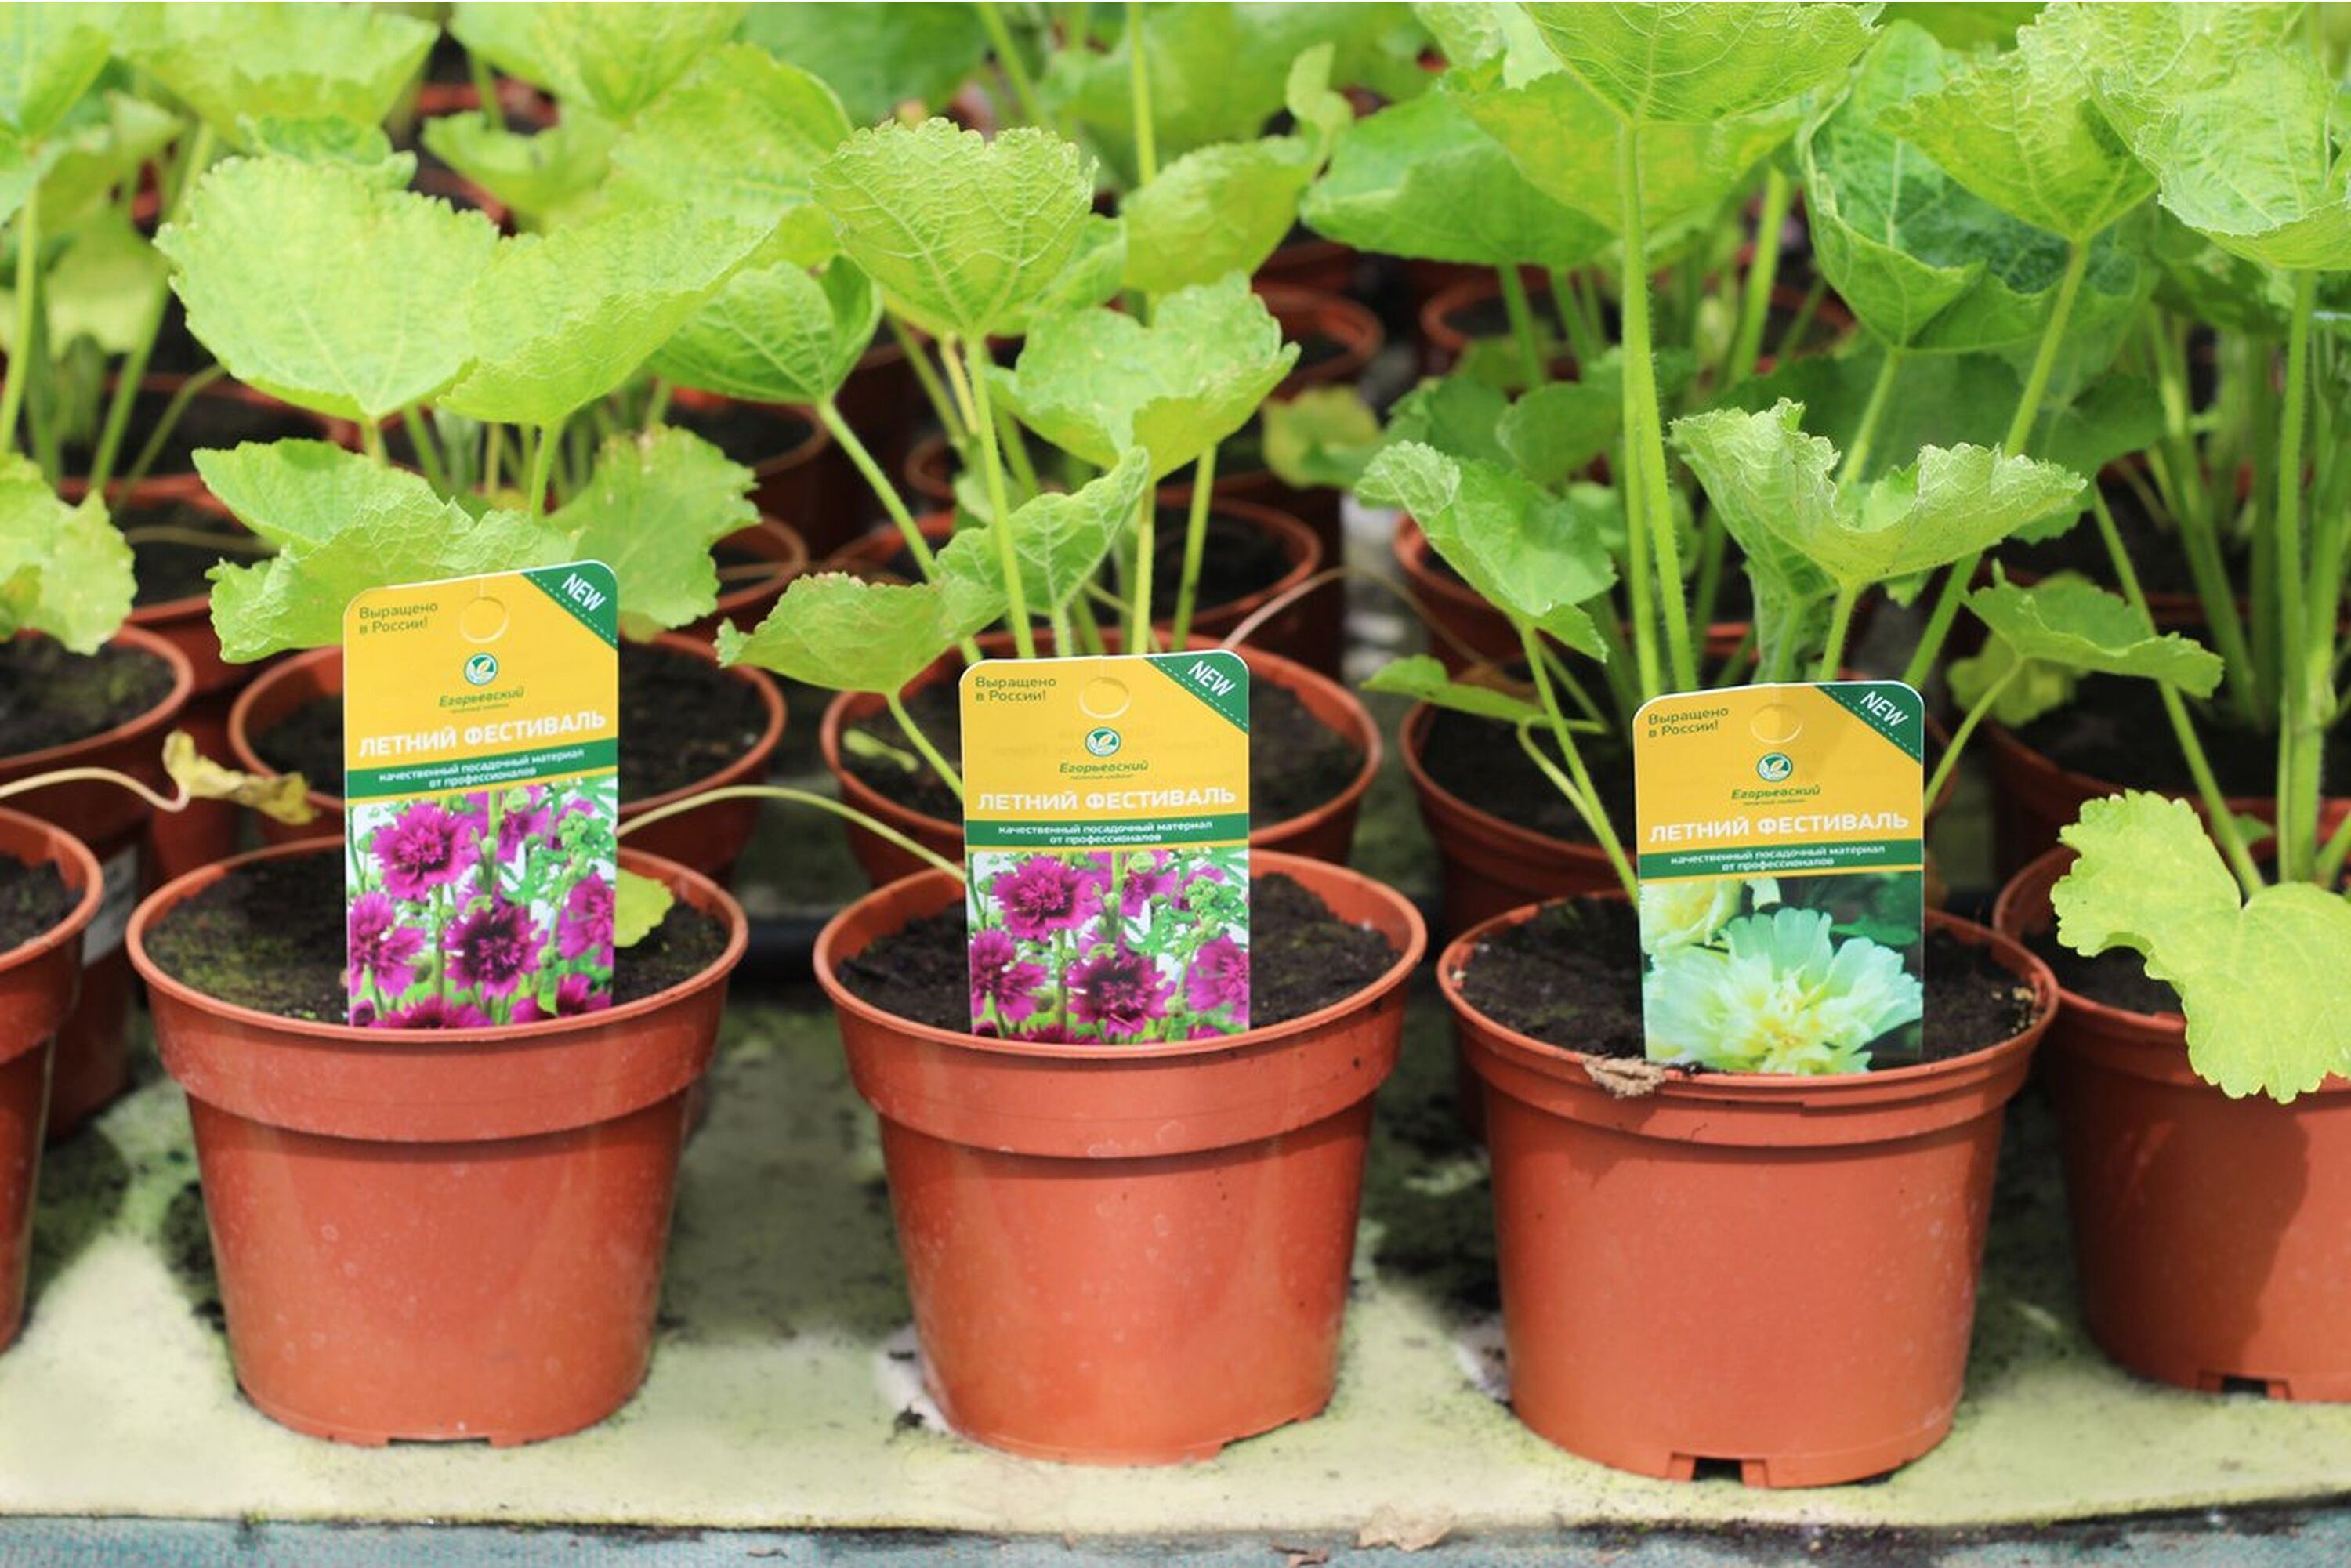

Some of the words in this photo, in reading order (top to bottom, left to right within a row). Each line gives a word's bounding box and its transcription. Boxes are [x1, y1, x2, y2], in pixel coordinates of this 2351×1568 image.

[561, 572, 607, 612] NEW
[359, 603, 438, 621] Выращено
[359, 625, 368, 635] в
[372, 617, 429, 633] России!
[975, 676, 1056, 690] Выращено
[1187, 660, 1236, 697] NEW
[439, 686, 524, 707] Егорьевский
[976, 692, 984, 701] в
[989, 690, 1046, 701] России!
[1648, 707, 1729, 726] Выращено
[1860, 690, 1908, 727] NEW
[358, 726, 457, 758] ЛЕТНИЙ
[464, 710, 607, 744] ФЕСТИВАЛЬ
[1648, 729, 1657, 738] в
[1661, 720, 1719, 737] России!
[379, 764, 459, 782] качественный
[461, 755, 530, 773] посадочный
[531, 749, 585, 765] материал
[1059, 760, 1148, 773] Егорьевский
[429, 777, 442, 788] от
[444, 766, 537, 788] профессионалов
[977, 790, 1078, 811] ЛЕТНИЙ
[1085, 787, 1236, 810] ФЕСТИВАЛЬ
[1731, 784, 1821, 800] Егорьевский
[998, 824, 1081, 835] качественный
[1083, 822, 1154, 835] посадочный
[1157, 820, 1213, 831] материал
[1649, 817, 1750, 842] ЛЕТНИЙ
[1757, 812, 1908, 835] ФЕСТИВАЛЬ
[1049, 836, 1063, 845] от
[1065, 832, 1161, 846] профессионалов
[1671, 850, 1754, 865] качественный
[1755, 846, 1827, 861] посадочный
[1829, 845, 1886, 856] материал
[1722, 861, 1736, 871] от
[1738, 856, 1834, 871] профессионалов
